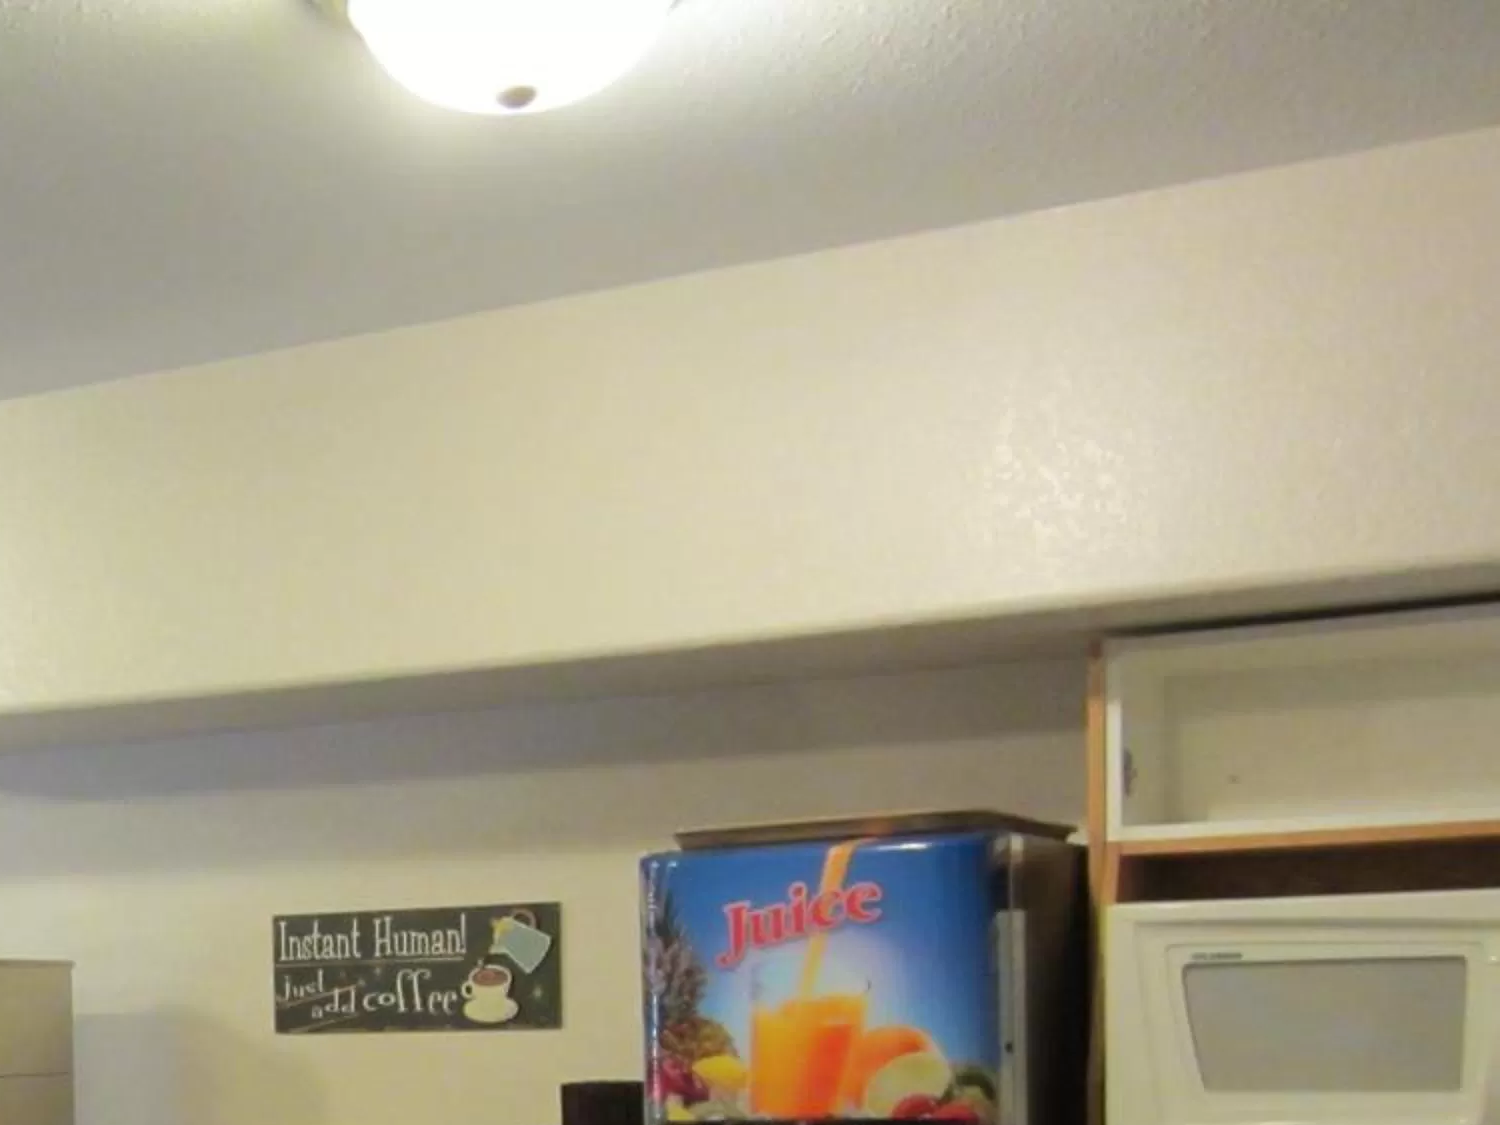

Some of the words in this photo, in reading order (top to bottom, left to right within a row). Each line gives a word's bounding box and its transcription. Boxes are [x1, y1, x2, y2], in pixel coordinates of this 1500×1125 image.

[278, 917, 362, 962] Instant
[373, 912, 467, 958] Human!
[717, 881, 882, 967] Juice
[311, 986, 356, 1019] add
[362, 967, 458, 1015] coffee
